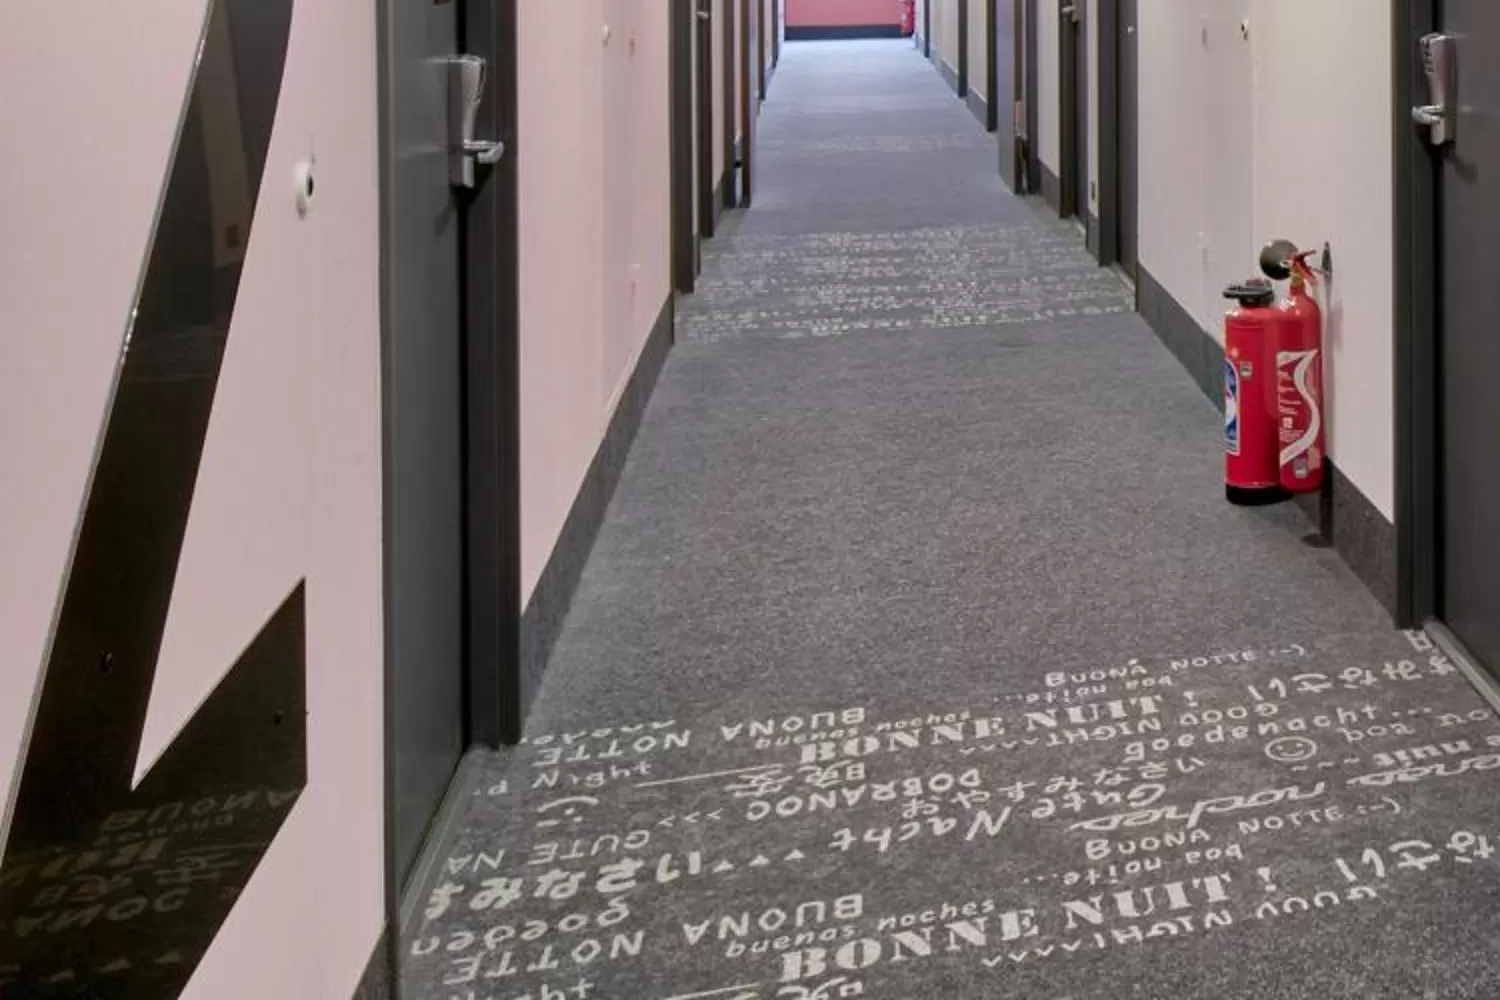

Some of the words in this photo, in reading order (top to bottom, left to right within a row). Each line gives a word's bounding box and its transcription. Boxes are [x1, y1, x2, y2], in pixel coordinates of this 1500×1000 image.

[720, 706, 866, 742] BUONA
[800, 716, 1005, 764] BONNE
[1024, 693, 1165, 732] NUIT
[1180, 701, 1279, 727] GOOD
[532, 729, 692, 767] NOTTE
[746, 768, 981, 822] DOBRANOC
[1031, 783, 1166, 819] Gute
[528, 829, 650, 866] GUTE
[828, 808, 1012, 853] Nacht
[1085, 828, 1211, 861] BUONA
[1238, 804, 1345, 835] NOTTE
[1185, 843, 1245, 865] boa
[683, 893, 864, 946] BUONA
[725, 924, 856, 958] buenas
[876, 899, 995, 932] noches
[777, 908, 1040, 983] BONNE
[1061, 871, 1232, 930] NUIT
[443, 929, 646, 986] NOTTE
